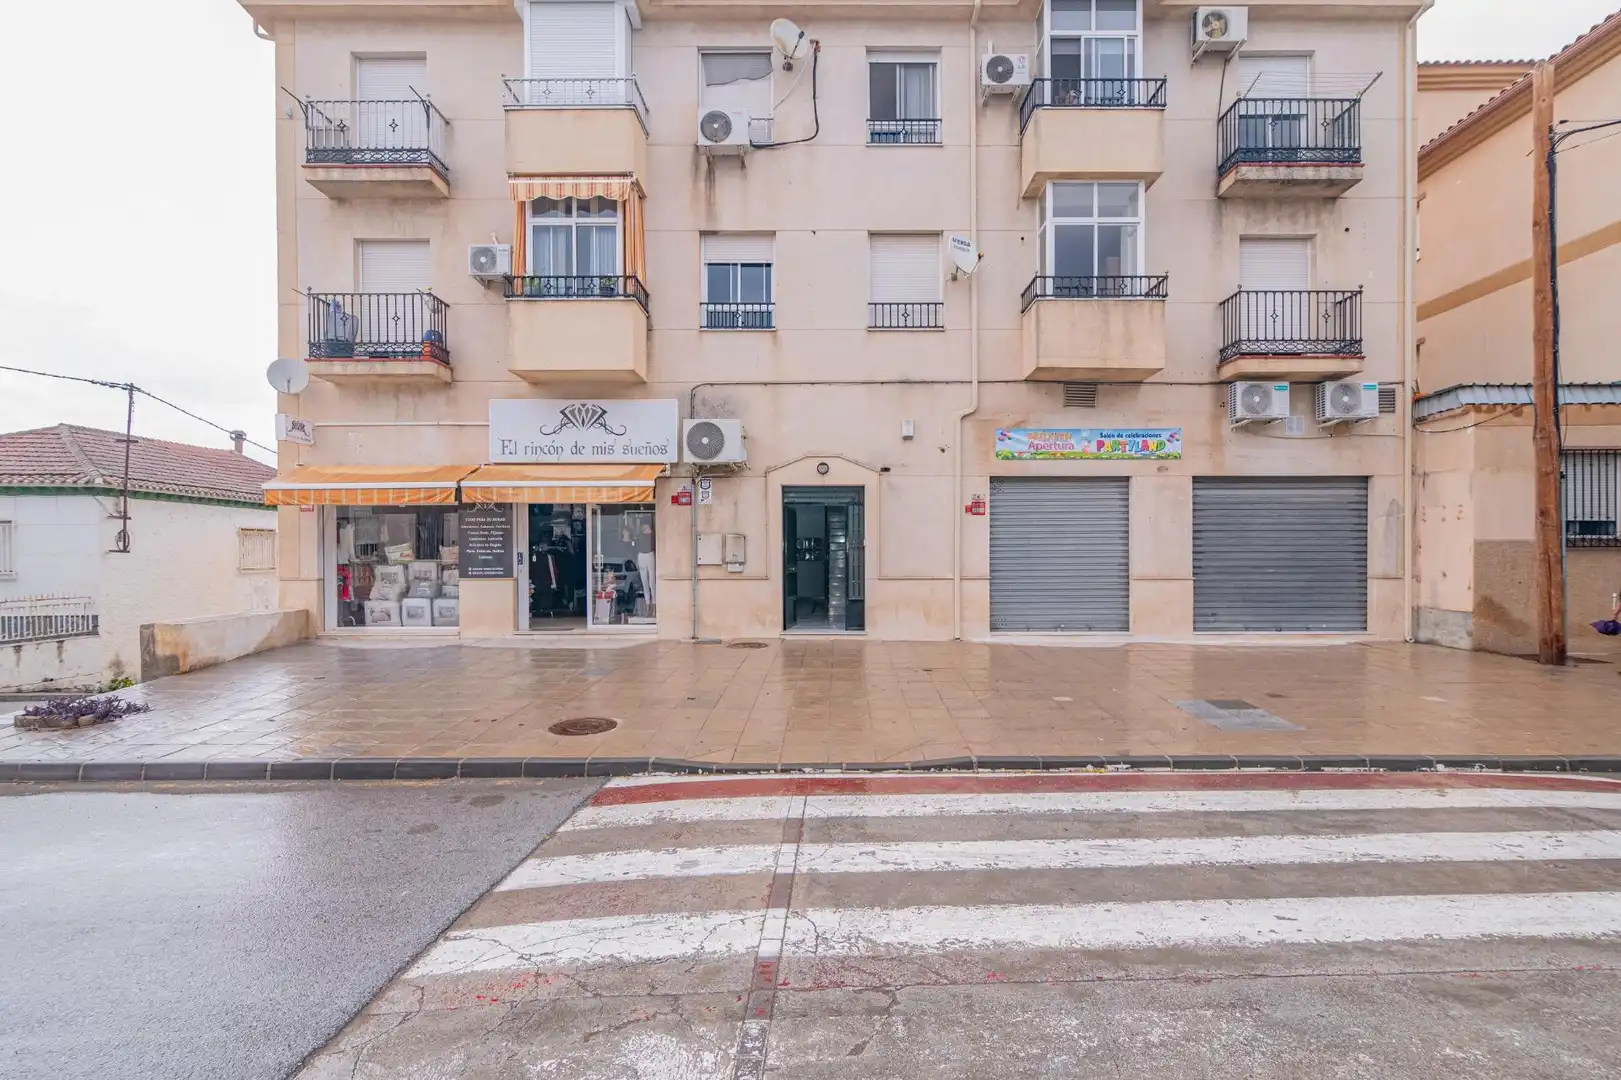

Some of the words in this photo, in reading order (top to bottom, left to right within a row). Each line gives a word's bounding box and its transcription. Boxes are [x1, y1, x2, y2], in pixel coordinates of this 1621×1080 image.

[498, 437, 517, 456] El
[524, 439, 564, 461] rincón
[570, 440, 585, 456] de
[591, 438, 617, 456] mis
[622, 438, 670, 456] sueños
[1028, 440, 1075, 451] Apertura
[1096, 439, 1166, 454] PARTYLAND
